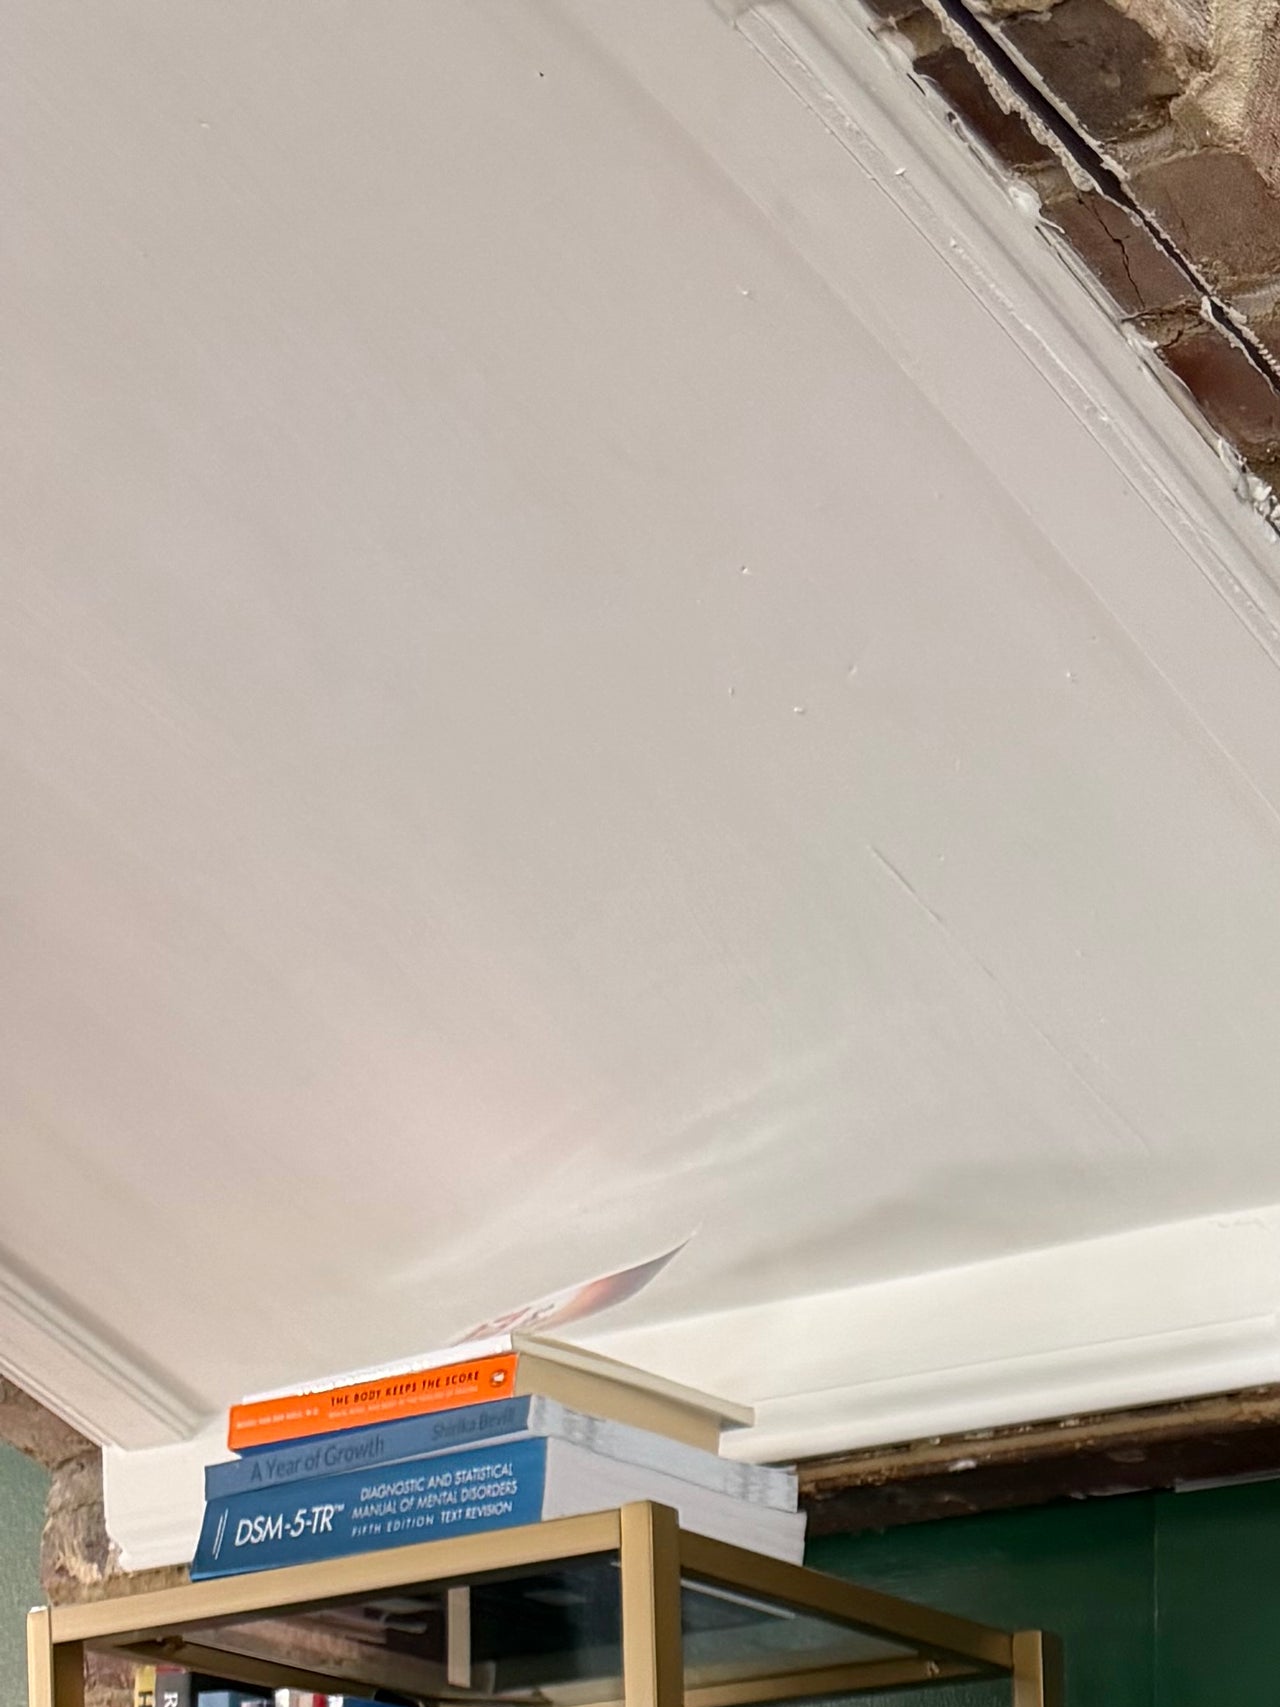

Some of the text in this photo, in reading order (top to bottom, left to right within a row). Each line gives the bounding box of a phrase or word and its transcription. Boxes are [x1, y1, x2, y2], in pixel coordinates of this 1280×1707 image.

[330, 1371, 480, 1407] THE BODY KEEPS THE SCORE
[250, 1436, 385, 1483] A Year of Growth
[352, 1480, 518, 1520] MANUAL OF MENTAL DISORDERS
[360, 1462, 514, 1501] DIAGNOSTIC AND STATISTICAL
[352, 1501, 513, 1537] FIFTH EDITION TEXT REVISION
